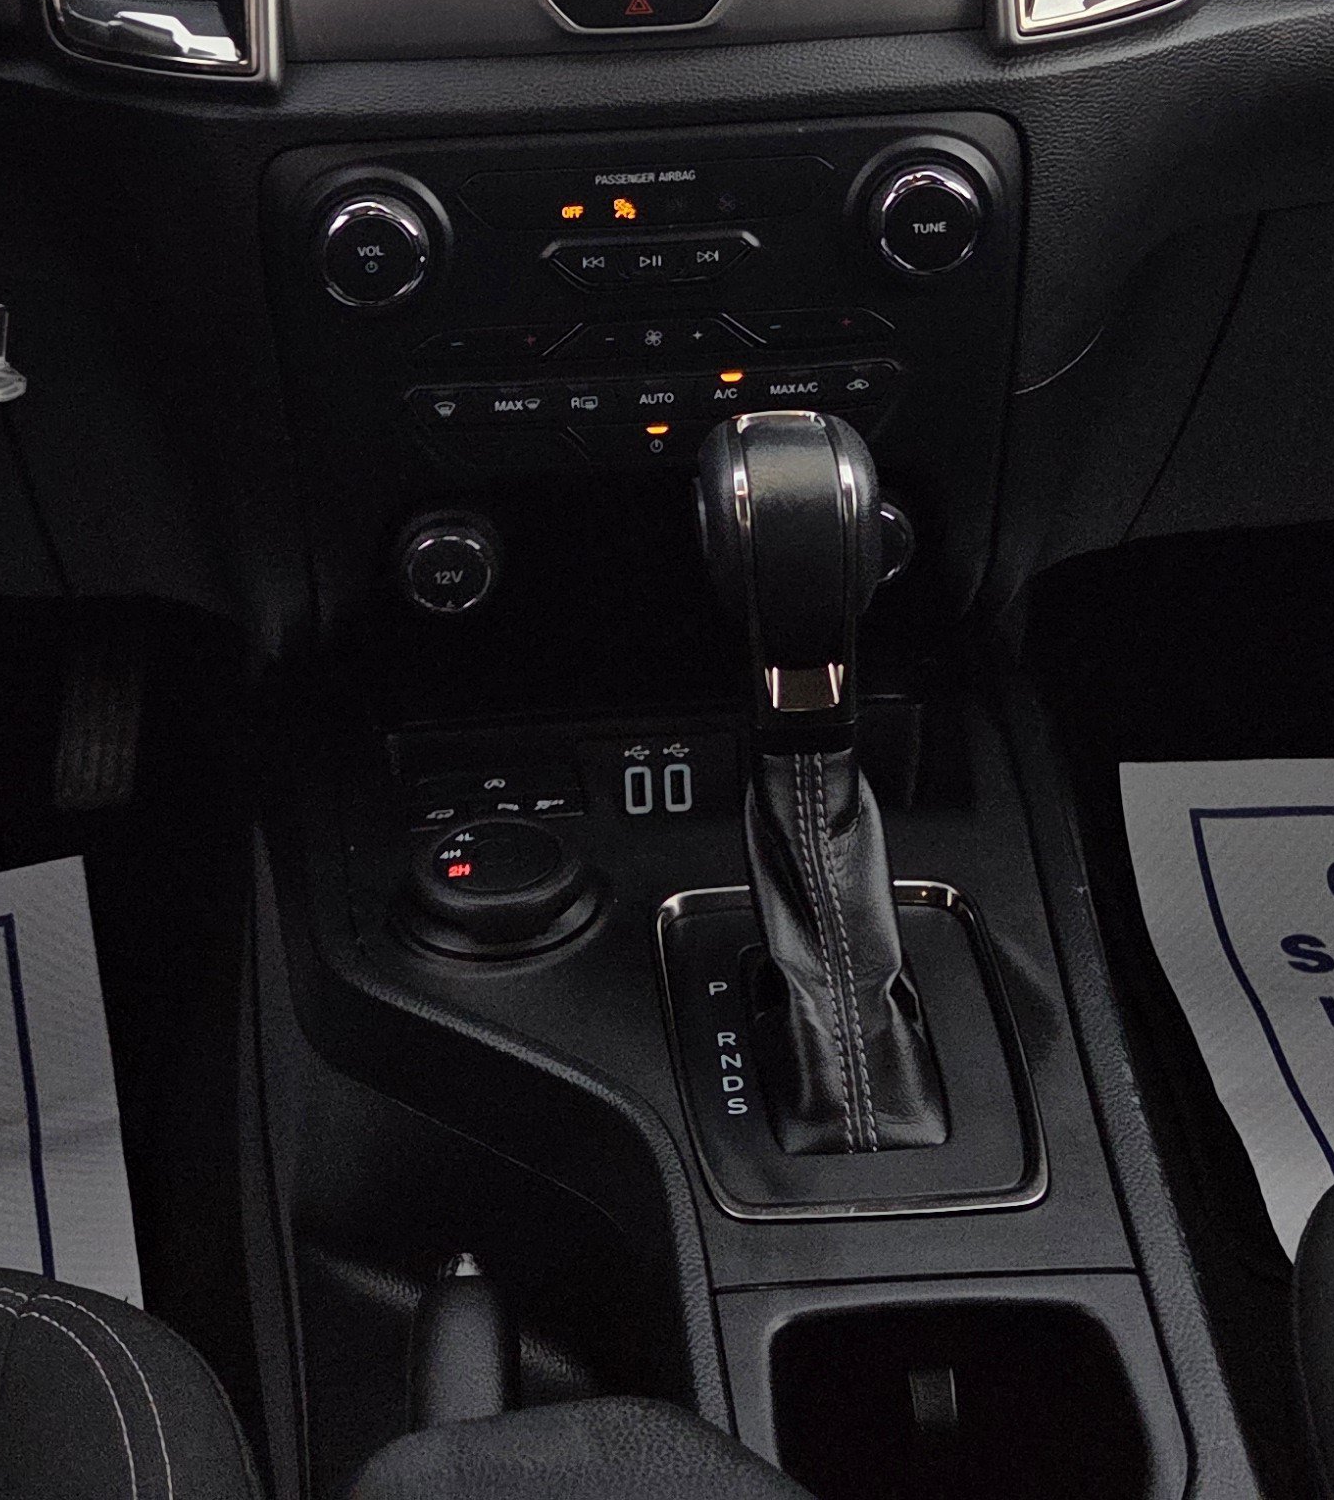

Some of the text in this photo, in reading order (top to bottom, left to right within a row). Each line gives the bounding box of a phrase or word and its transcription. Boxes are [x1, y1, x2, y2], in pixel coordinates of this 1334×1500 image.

[594, 169, 696, 185] PASSENGER AIRBAG
[561, 204, 584, 219] OFF
[912, 220, 947, 236] TUNE
[357, 245, 384, 258] VOL
[714, 388, 738, 401] A/C
[769, 382, 819, 396] MAX A/C
[494, 399, 523, 412] MAX
[639, 391, 675, 405] AUTO
[434, 570, 463, 585] 12V
[439, 849, 462, 859] 4H
[448, 863, 471, 878] 2H
[708, 981, 728, 996] P
[717, 1031, 737, 1047] R
[720, 1052, 743, 1070] N
[722, 1075, 744, 1092] D
[727, 1097, 748, 1115] S
